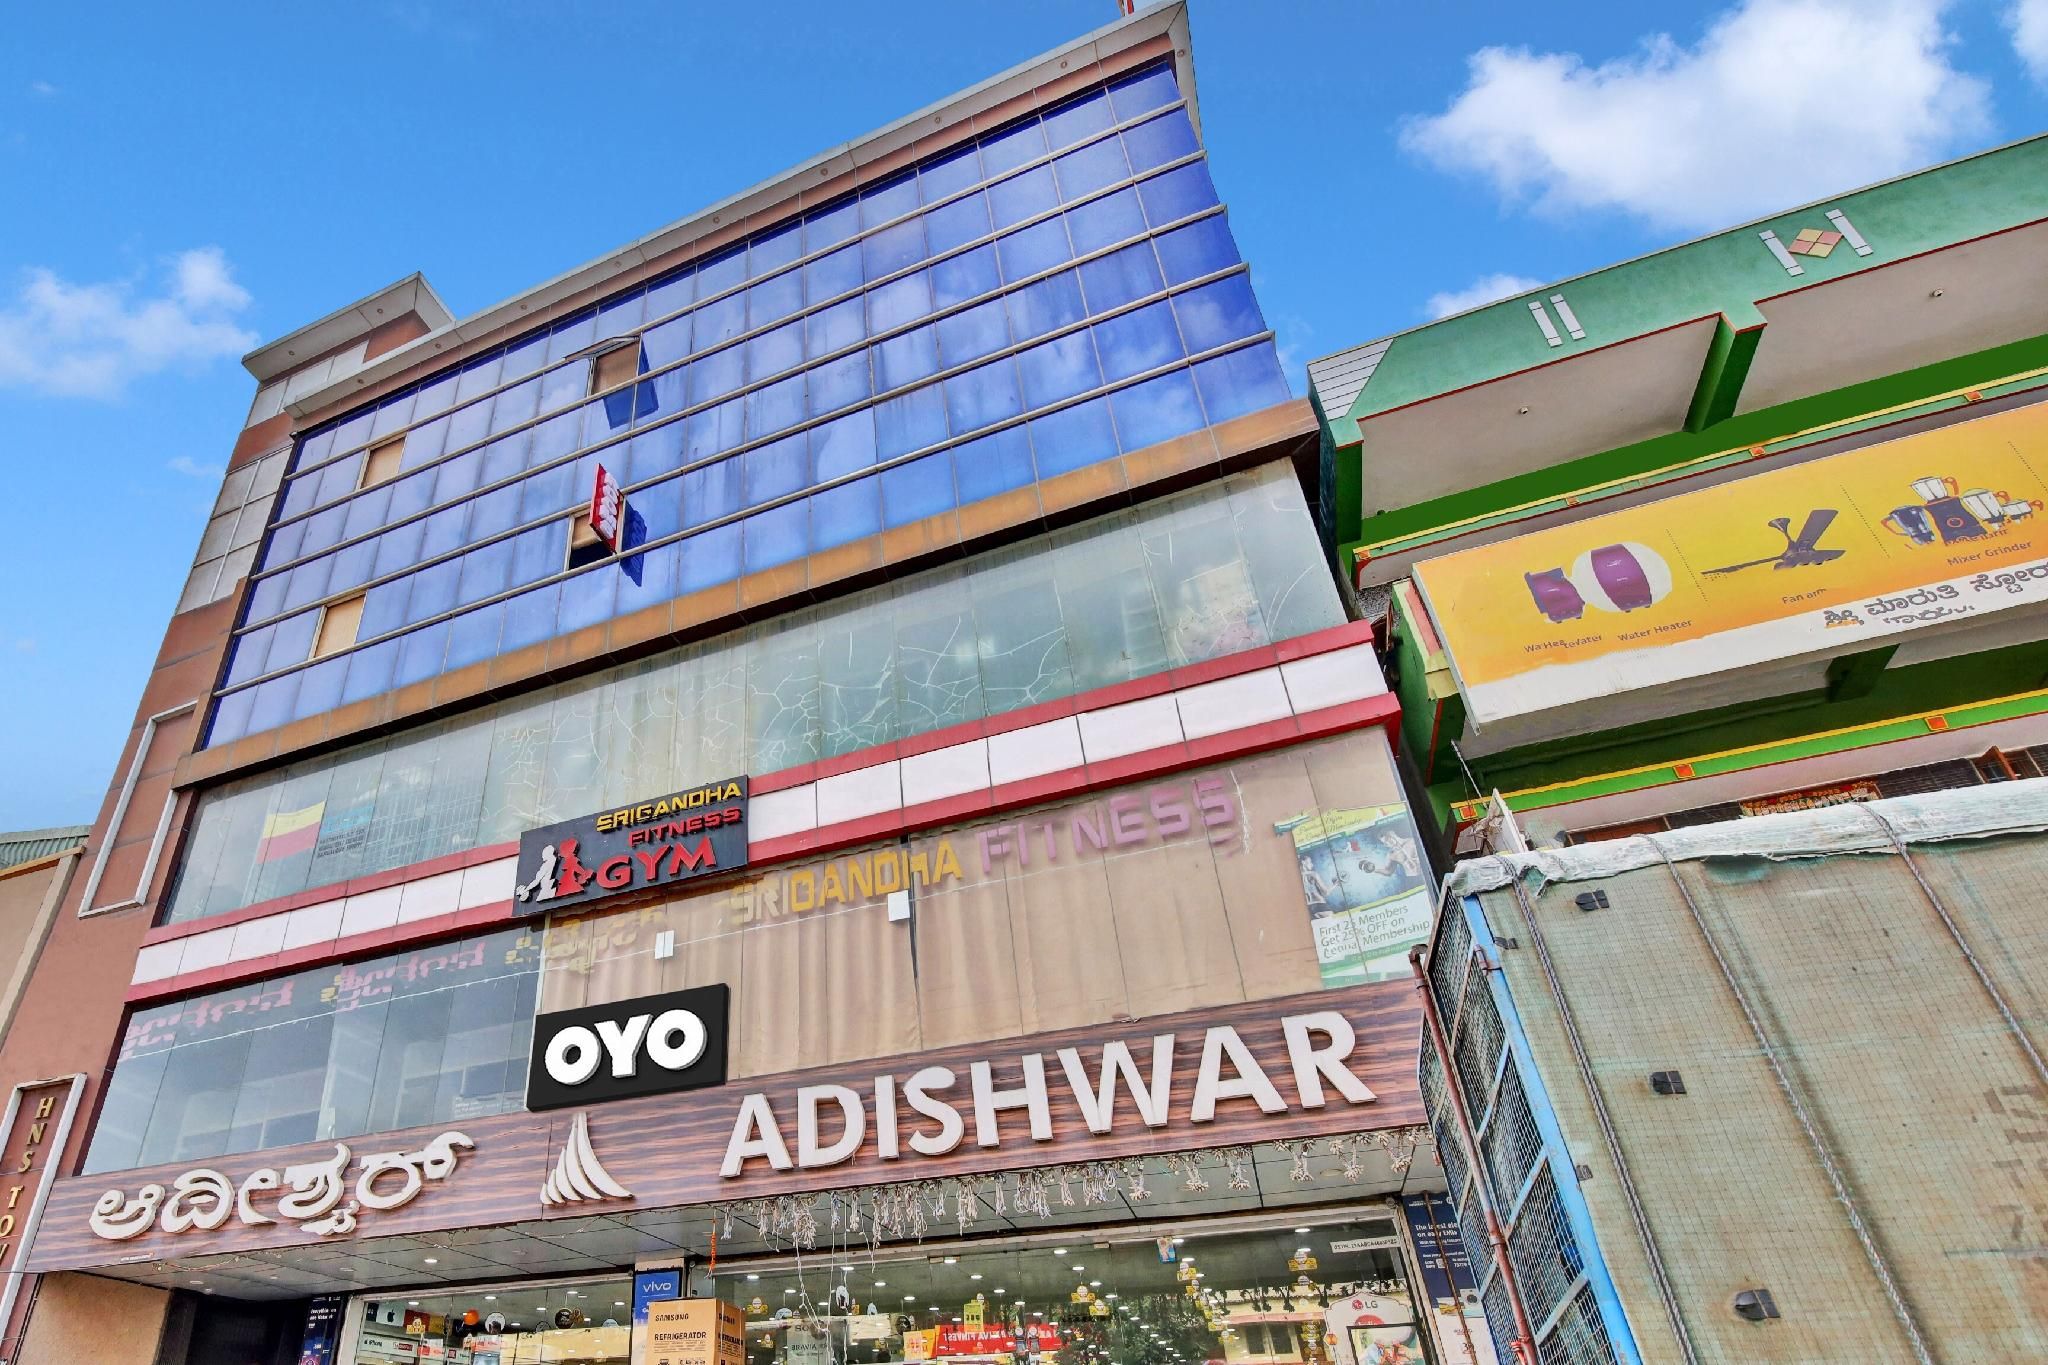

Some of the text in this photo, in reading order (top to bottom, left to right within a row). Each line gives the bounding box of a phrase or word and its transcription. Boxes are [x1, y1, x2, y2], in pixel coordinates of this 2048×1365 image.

[1947, 540, 2032, 567] Mixer Grinder
[1782, 591, 1804, 605] Fan
[1617, 619, 1693, 642] Water Heater
[596, 782, 742, 832] SRIGANDHA
[628, 807, 742, 847] FITNESS
[978, 777, 1236, 873] FITNESS
[596, 837, 717, 889] GYM
[1319, 923, 1341, 937] First
[1359, 906, 1409, 926] Members
[1321, 935, 1342, 948] Get
[1367, 921, 1389, 934] OFF
[1391, 917, 1405, 928] on
[1363, 921, 1431, 947] Membership
[544, 1008, 707, 1086] OYO
[719, 1011, 1377, 1178] ADISHWAR
[17, 1096, 56, 1174] HNS
[642, 1281, 672, 1293] vivo
[655, 1313, 689, 1322] SAMSUNG
[1364, 1300, 1378, 1309] LG
[654, 1331, 707, 1342] REFRIGERATOR
